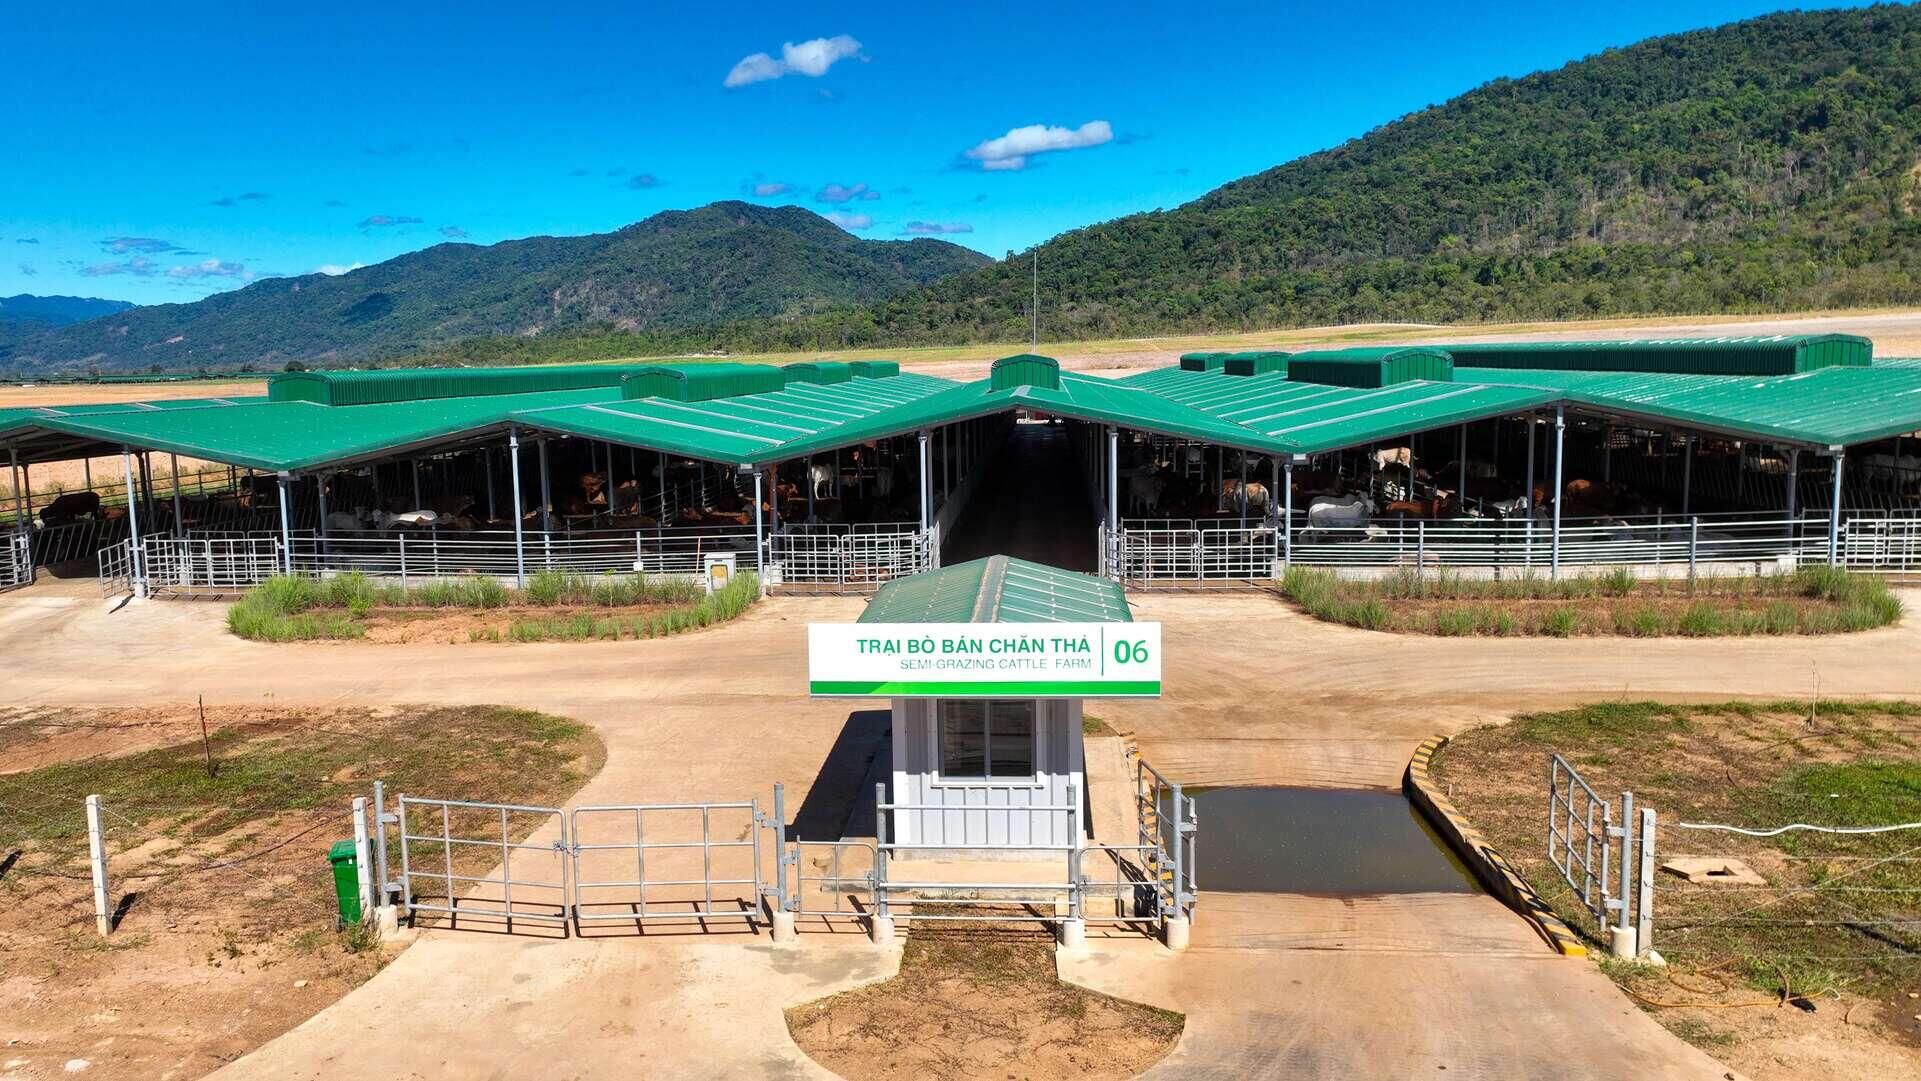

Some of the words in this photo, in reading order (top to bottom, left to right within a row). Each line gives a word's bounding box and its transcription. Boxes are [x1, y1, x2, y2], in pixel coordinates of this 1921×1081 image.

[856, 639, 901, 656] TRẠI
[907, 635, 935, 654] BÒ
[941, 635, 983, 654] BÁN
[989, 635, 1045, 653] CHĂN
[1050, 635, 1091, 653] THẢ
[1114, 639, 1149, 664] 06
[900, 659, 995, 670] SEMI-GRAZING
[999, 658, 1047, 669] CATTLE
[1055, 658, 1091, 669] FARM
